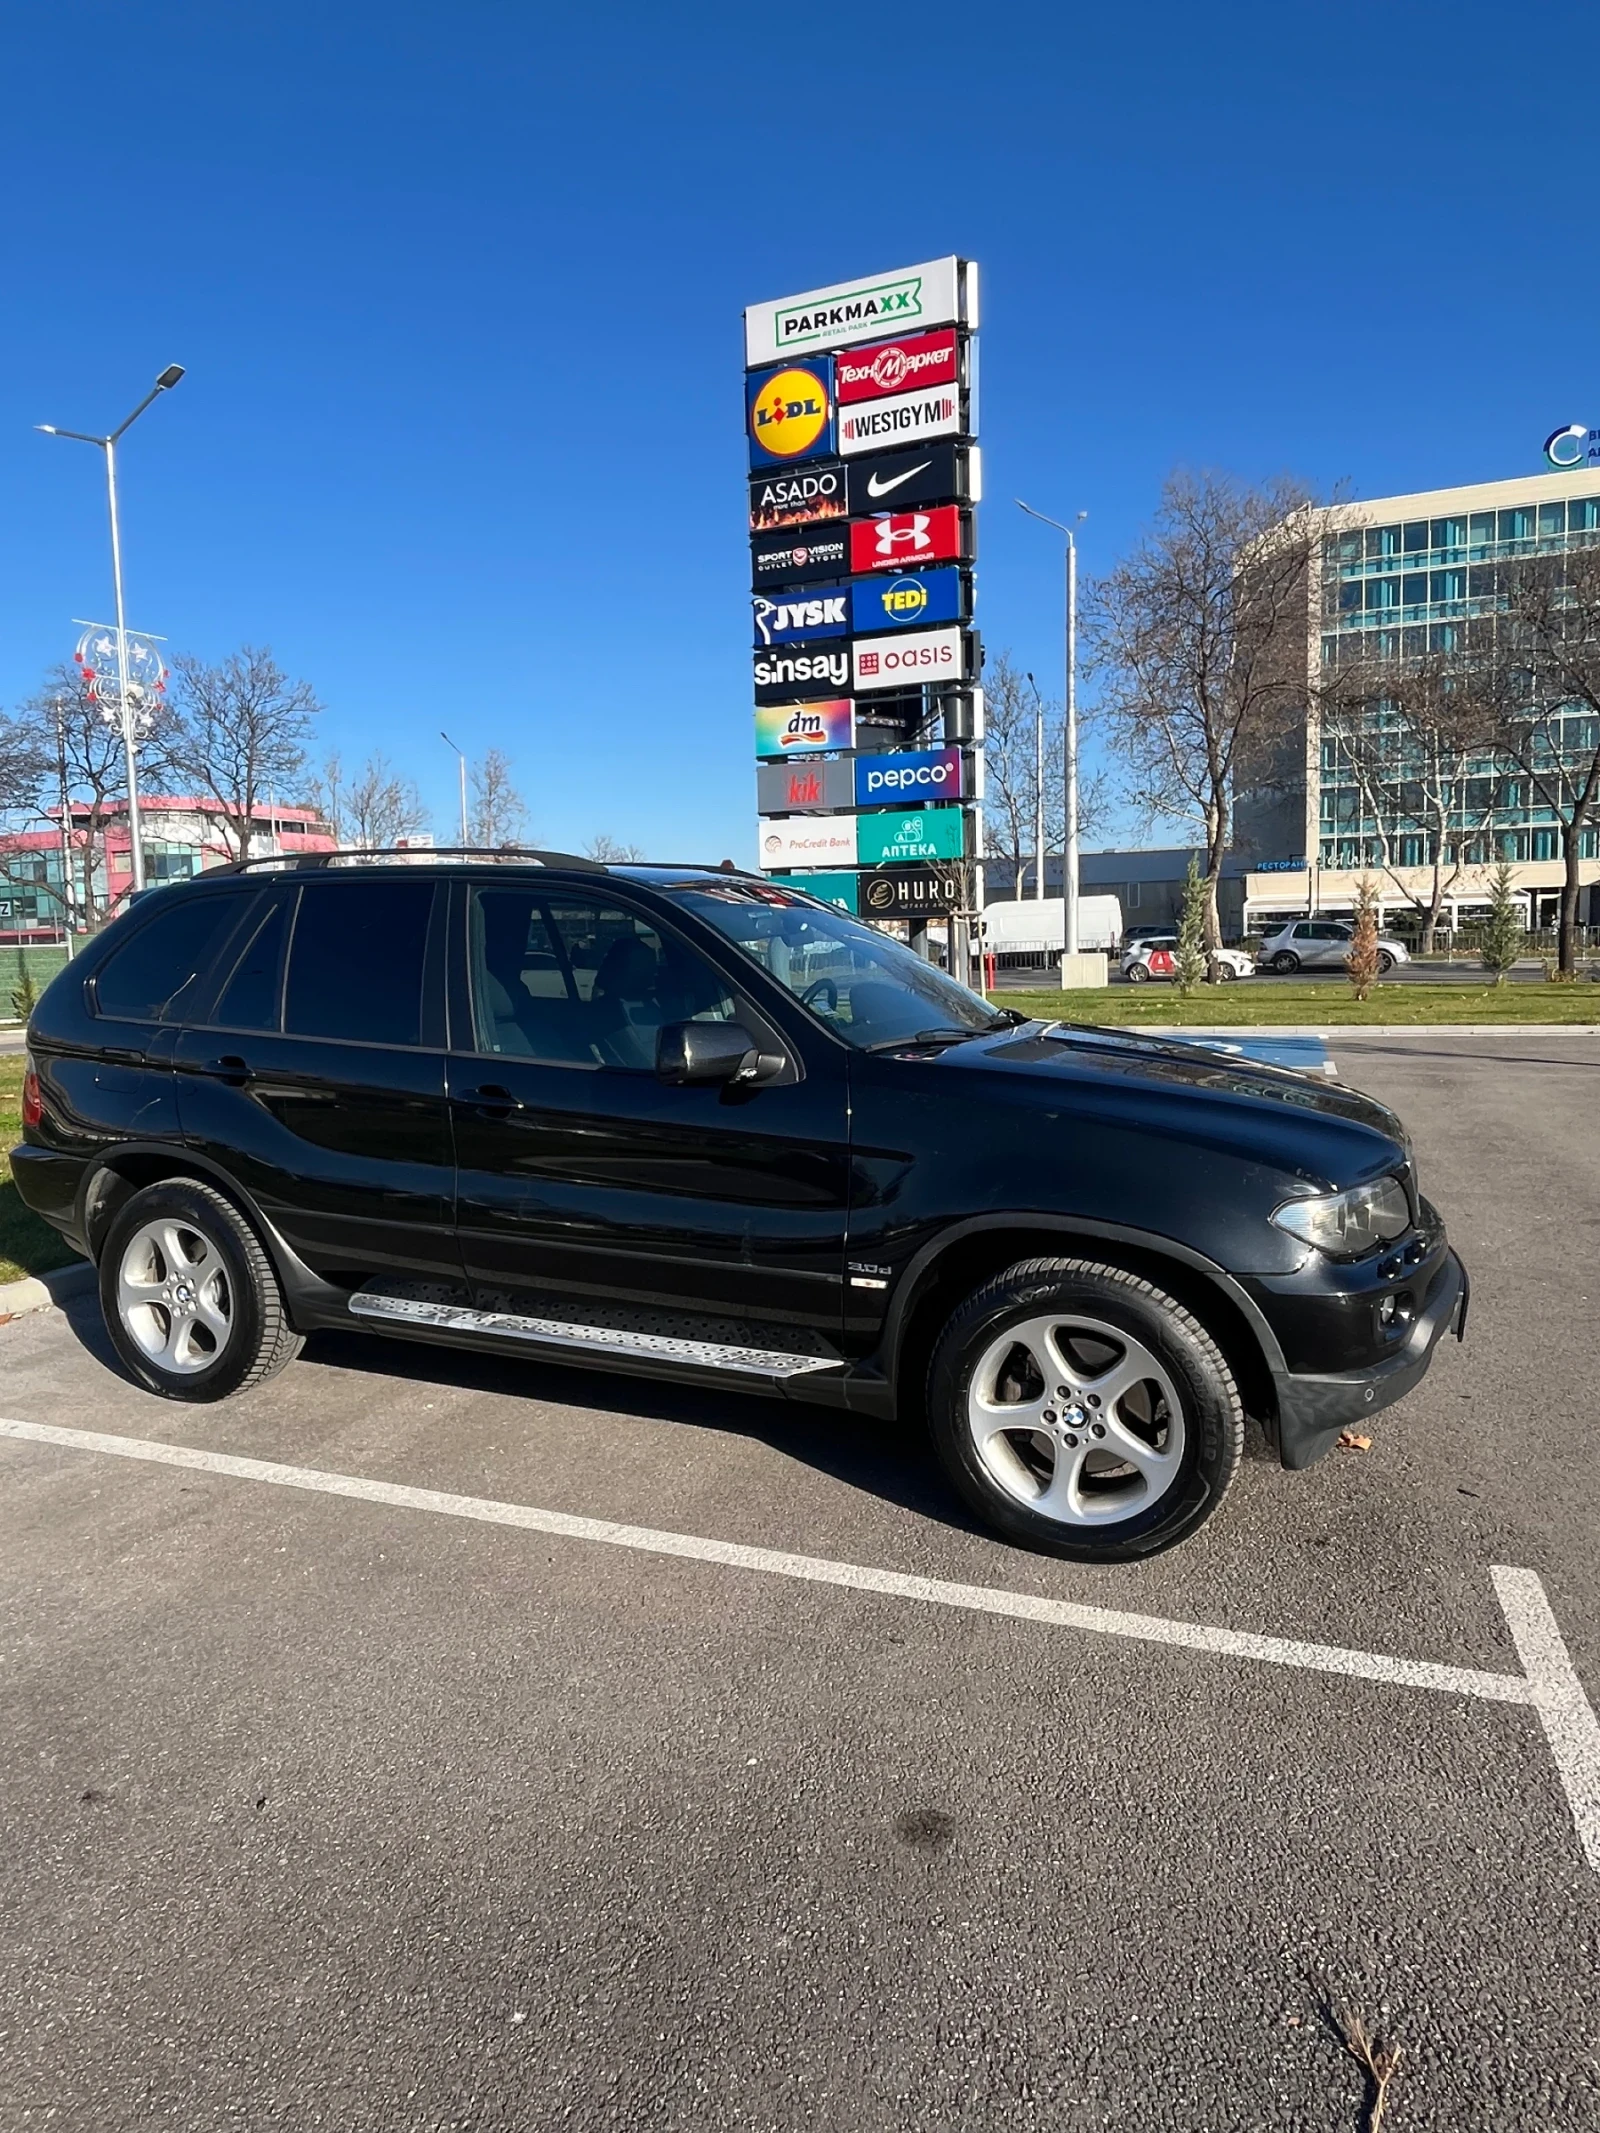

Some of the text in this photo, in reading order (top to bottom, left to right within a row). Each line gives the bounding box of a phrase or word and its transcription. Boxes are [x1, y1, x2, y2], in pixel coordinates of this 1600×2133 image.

[785, 292, 910, 336] PARKMAXX
[855, 401, 942, 438] WESTGYM
[760, 473, 838, 507] ASADO
[790, 499, 806, 508] than
[757, 542, 844, 563] SPORT VISION
[757, 553, 844, 572] OUTLET STORE
[872, 551, 935, 568] UNDER ARMOUR
[882, 588, 927, 611] TEDi
[773, 597, 847, 631] JYSK
[884, 645, 953, 668] oasis
[754, 653, 848, 686] sinsay
[787, 711, 821, 734] dm
[867, 765, 948, 792] pepco
[789, 837, 851, 849] ProCredit Bank
[881, 842, 937, 858] АПТЕКА
